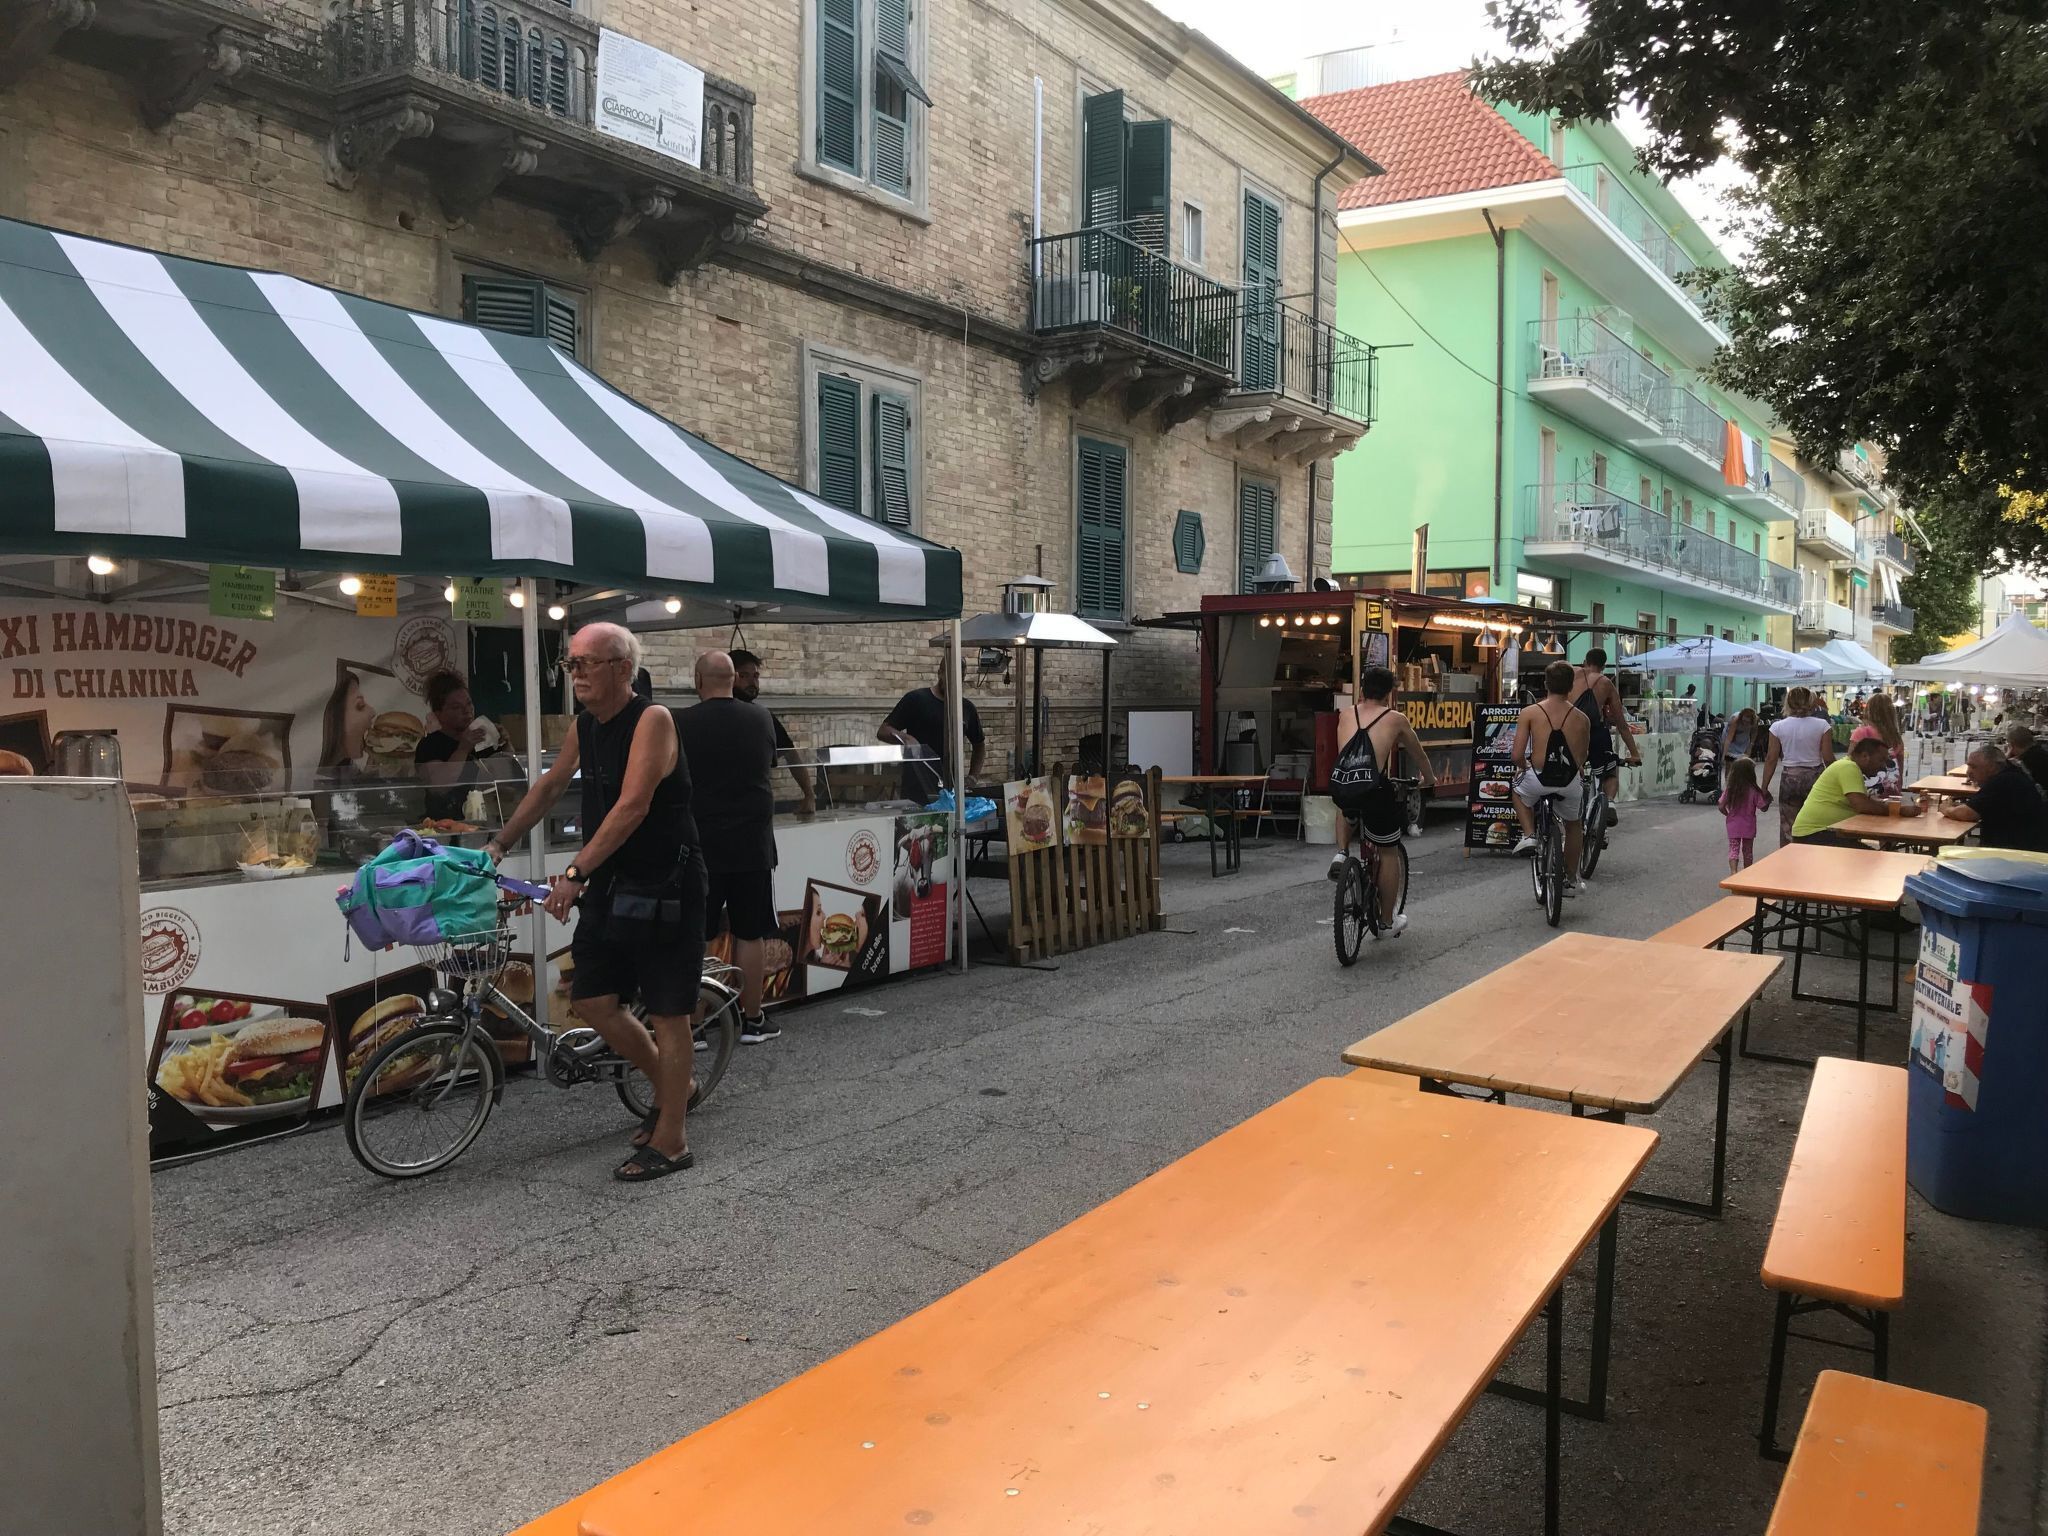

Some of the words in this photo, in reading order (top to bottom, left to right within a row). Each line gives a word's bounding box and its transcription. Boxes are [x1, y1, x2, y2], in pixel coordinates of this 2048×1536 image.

[605, 100, 657, 126] CIARROCCHI
[460, 585, 495, 596] PATATINE
[0, 615, 40, 660] XI
[52, 611, 257, 678] HAMBURGER
[12, 668, 46, 699] DI
[53, 668, 199, 698] CHIANINA
[1407, 700, 1474, 729] BRACERIA
[1481, 707, 1521, 716] ARROSTI
[1492, 765, 1515, 773] TAGL
[1483, 806, 1517, 814] VESPAN
[155, 911, 186, 924] BIGGEST
[861, 947, 875, 971] cotti
[142, 952, 198, 992] MBURGER
[1915, 980, 1963, 1017] ULTIMATERIALE
